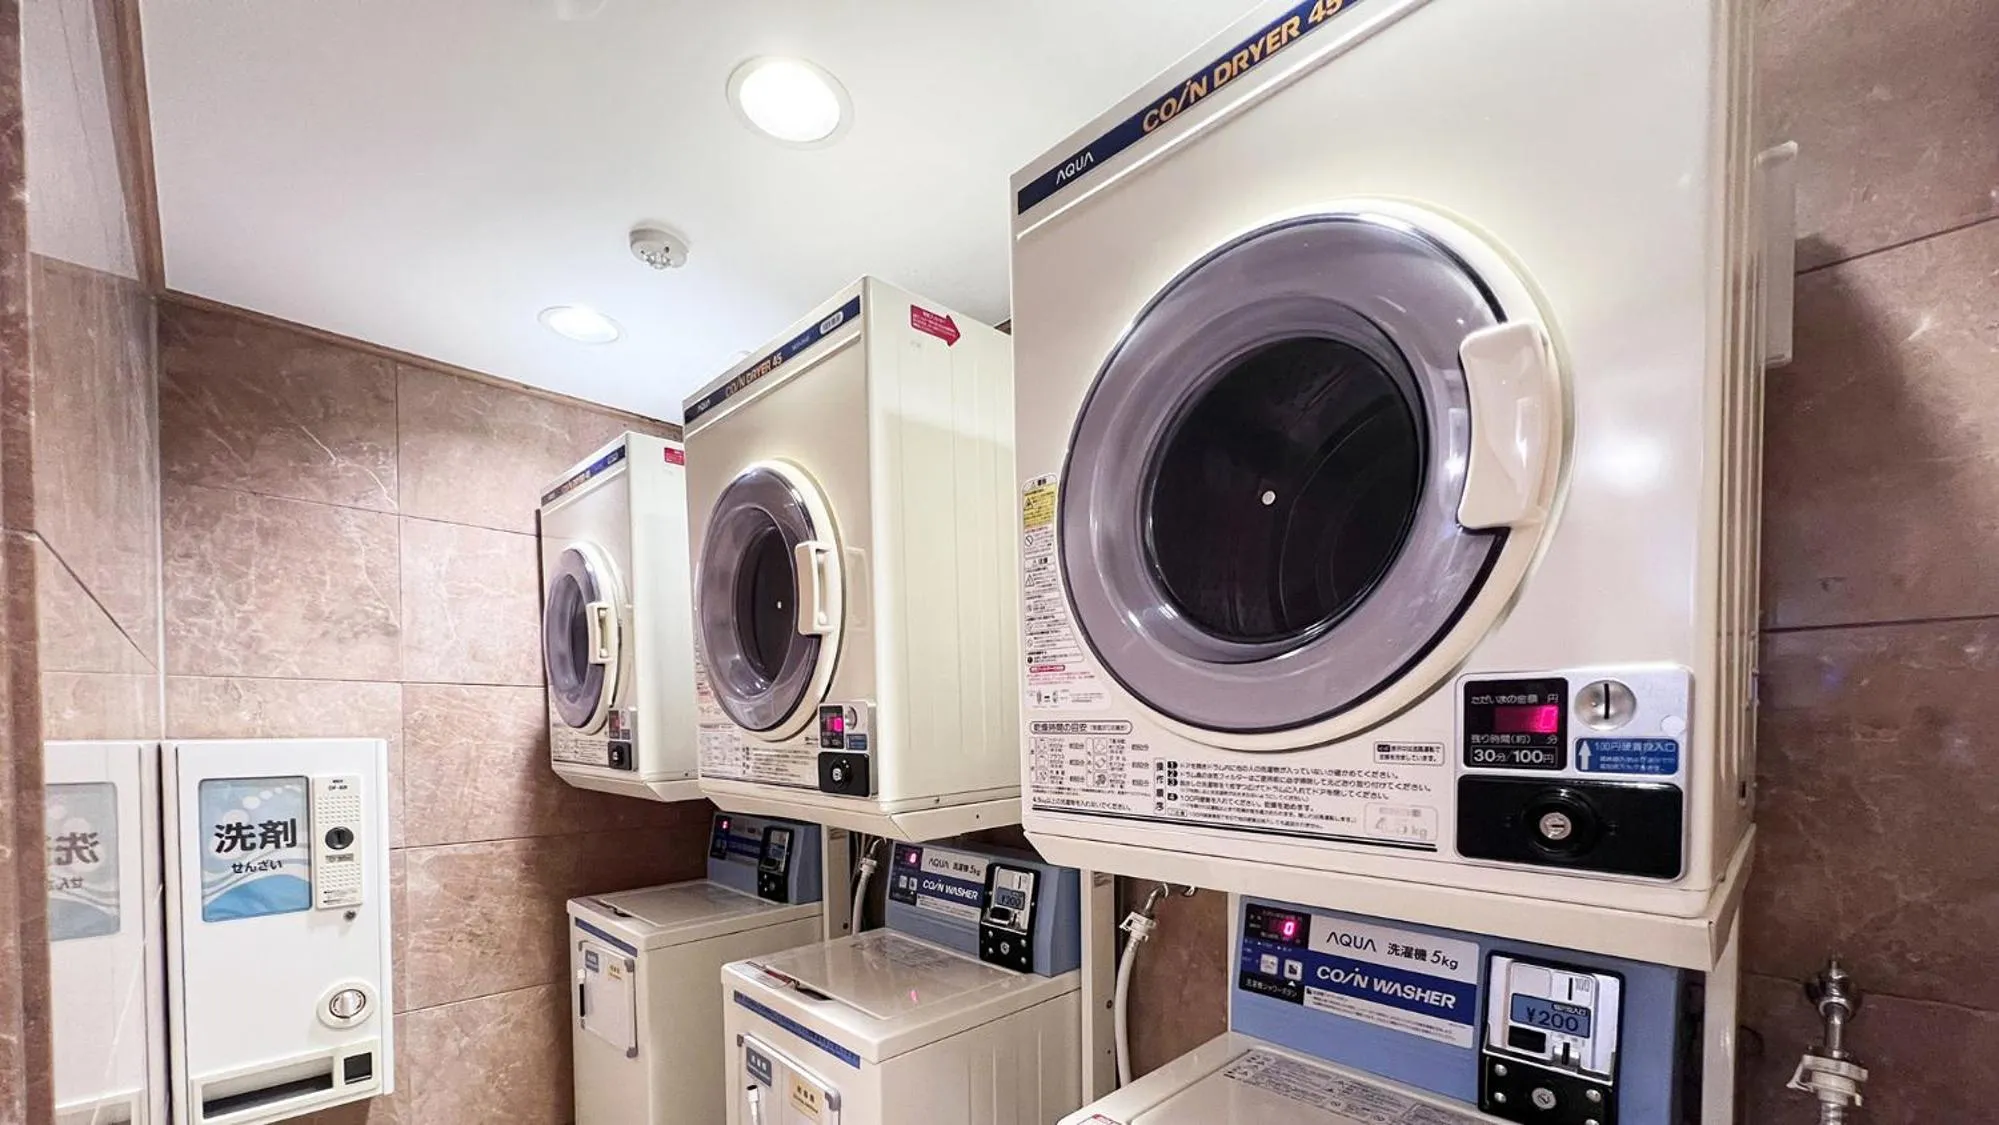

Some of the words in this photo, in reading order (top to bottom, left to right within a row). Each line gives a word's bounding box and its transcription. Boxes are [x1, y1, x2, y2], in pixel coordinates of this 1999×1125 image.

[1055, 150, 1095, 186] AQUA
[1212, 15, 1301, 89] DRYER
[214, 818, 297, 853] 洗剤
[231, 859, 283, 874] せんざい
[945, 885, 979, 900] WASHER
[1283, 921, 1295, 936] 0
[1326, 931, 1377, 953] AQUA
[1387, 942, 1428, 962] 洗濯機
[1430, 950, 1459, 971] 5kg
[1373, 978, 1457, 1010] WASHER
[1526, 1006, 1579, 1032] ¥200
